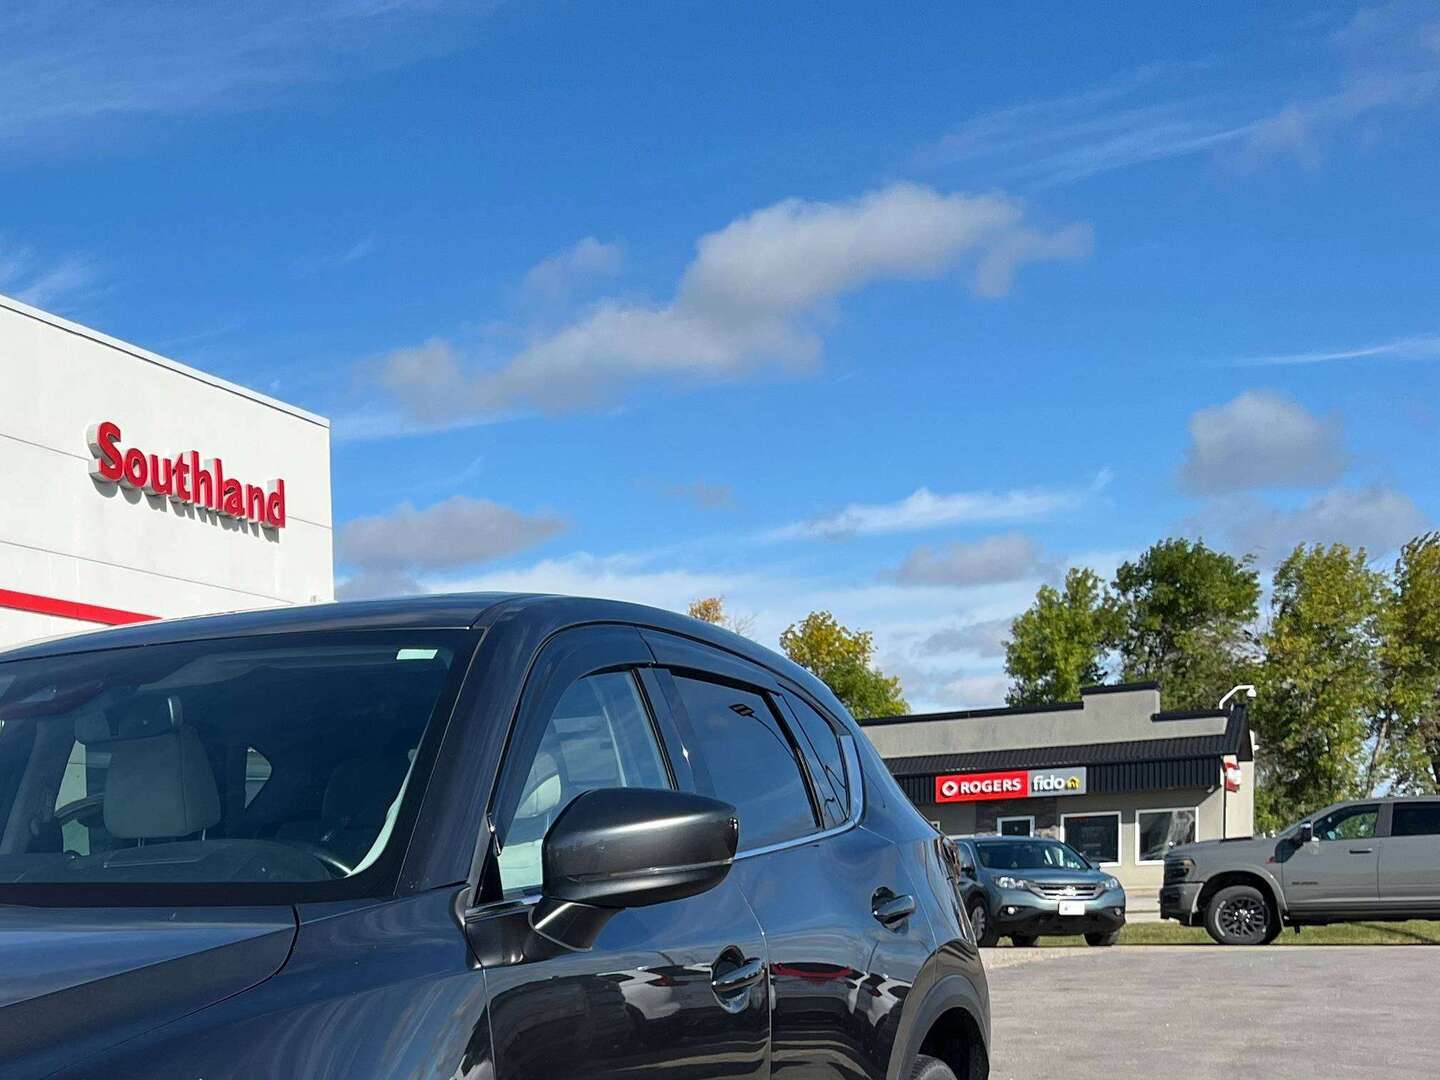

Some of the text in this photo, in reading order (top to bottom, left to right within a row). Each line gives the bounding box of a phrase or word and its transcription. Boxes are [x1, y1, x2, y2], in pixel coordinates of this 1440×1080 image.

[92, 421, 286, 529] Southland
[960, 778, 1022, 794] ROGERS
[1033, 774, 1064, 790] fido
